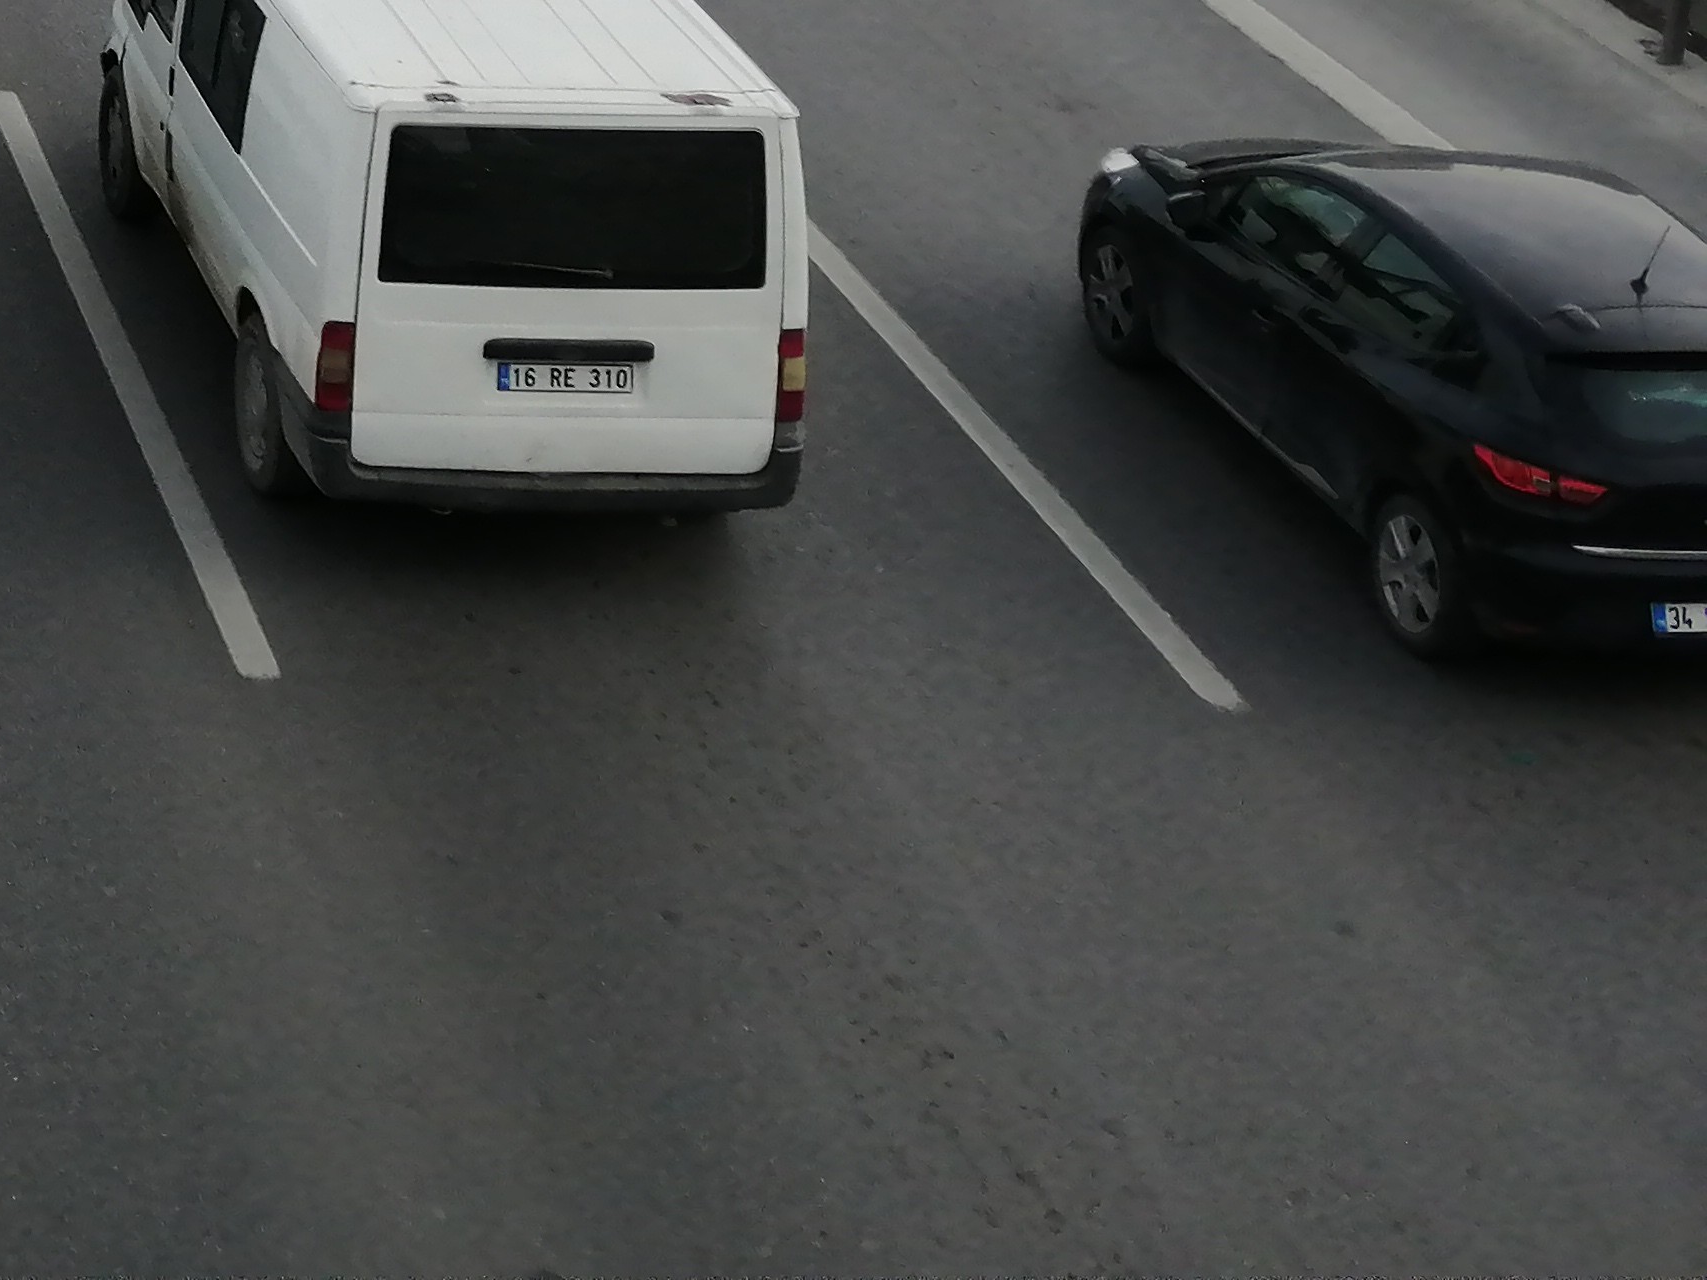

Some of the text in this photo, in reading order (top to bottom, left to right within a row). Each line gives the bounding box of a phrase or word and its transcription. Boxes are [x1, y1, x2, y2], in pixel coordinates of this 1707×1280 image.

[513, 367, 628, 389] 16 RE 310
[1668, 606, 1693, 630] 34
